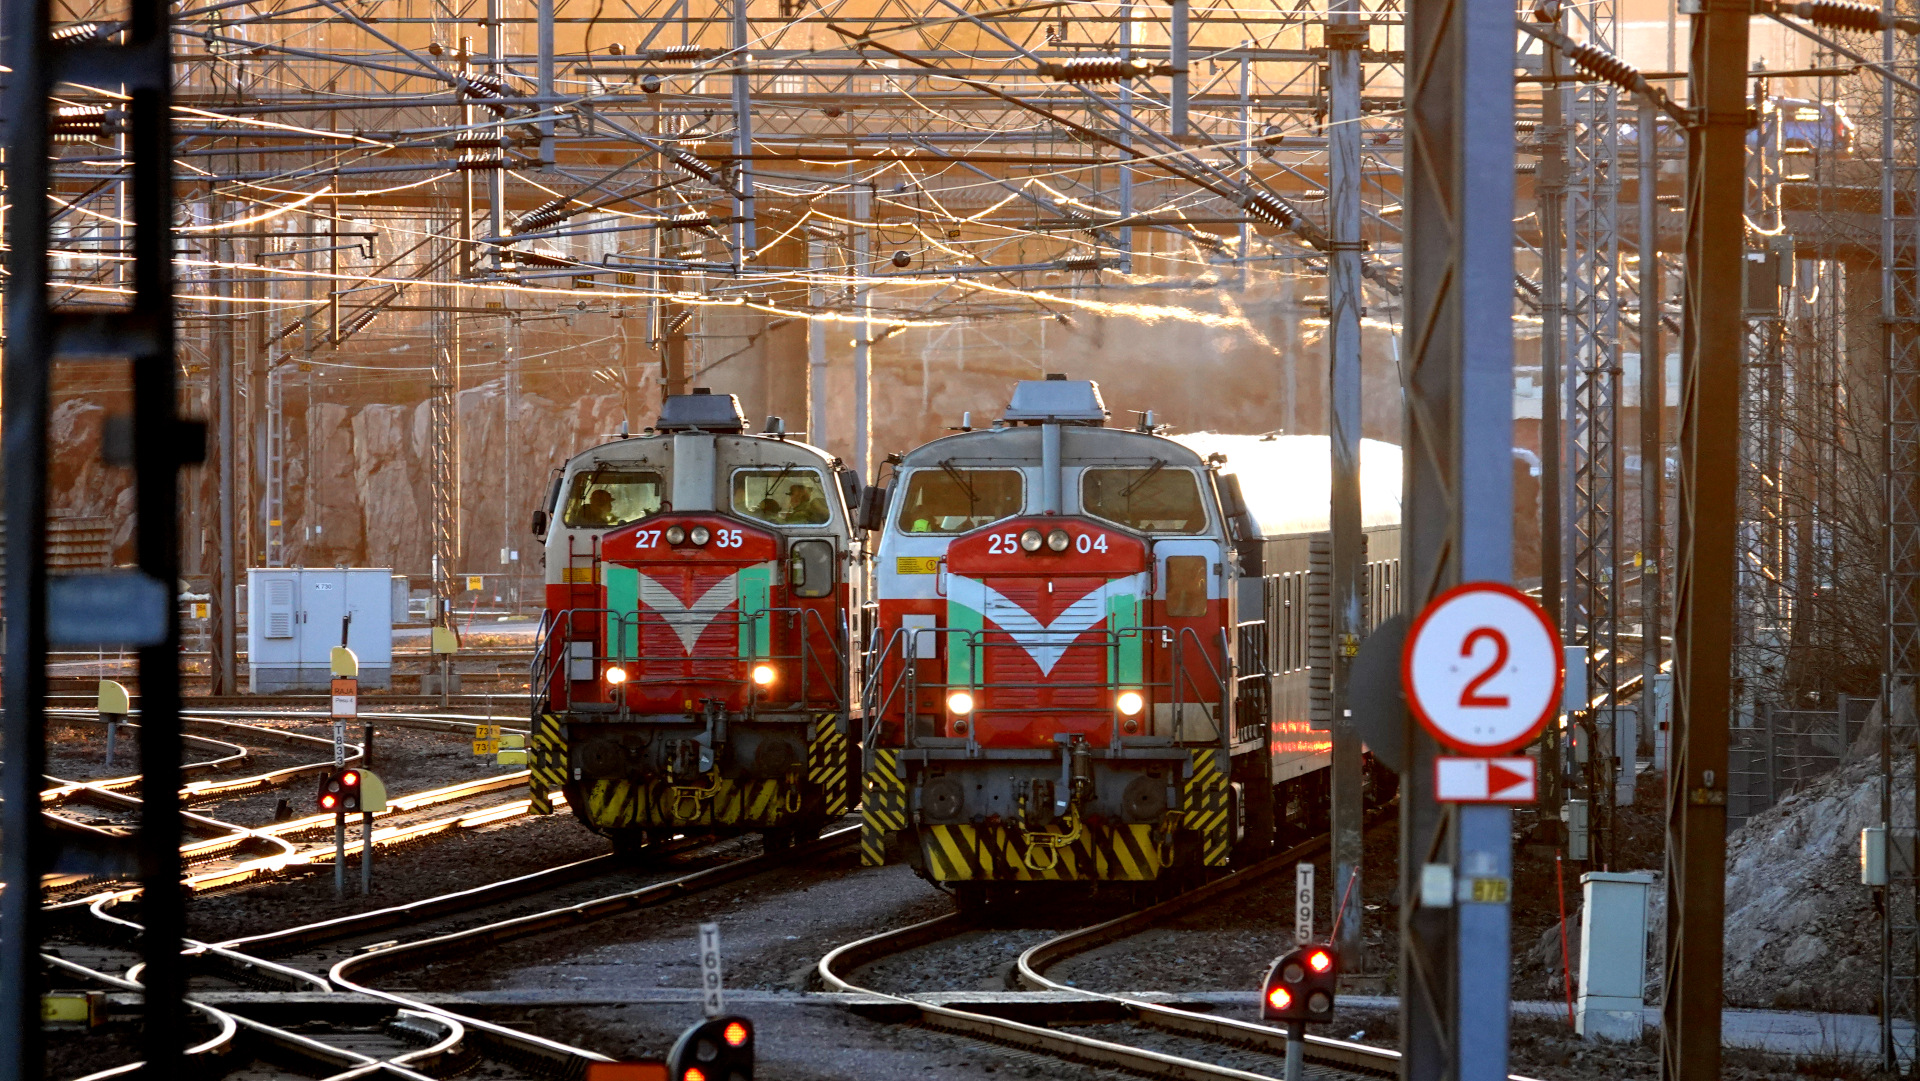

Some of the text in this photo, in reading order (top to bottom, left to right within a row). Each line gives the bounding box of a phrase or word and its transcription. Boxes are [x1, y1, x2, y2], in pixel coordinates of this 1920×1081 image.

[617, 272, 635, 284] 102
[635, 529, 743, 549] 27 35
[988, 533, 1109, 554] 25 04
[1460, 626, 1509, 708] 2
[335, 725, 343, 766] T833
[1300, 869, 1311, 940] T695
[703, 930, 719, 1007] T694
